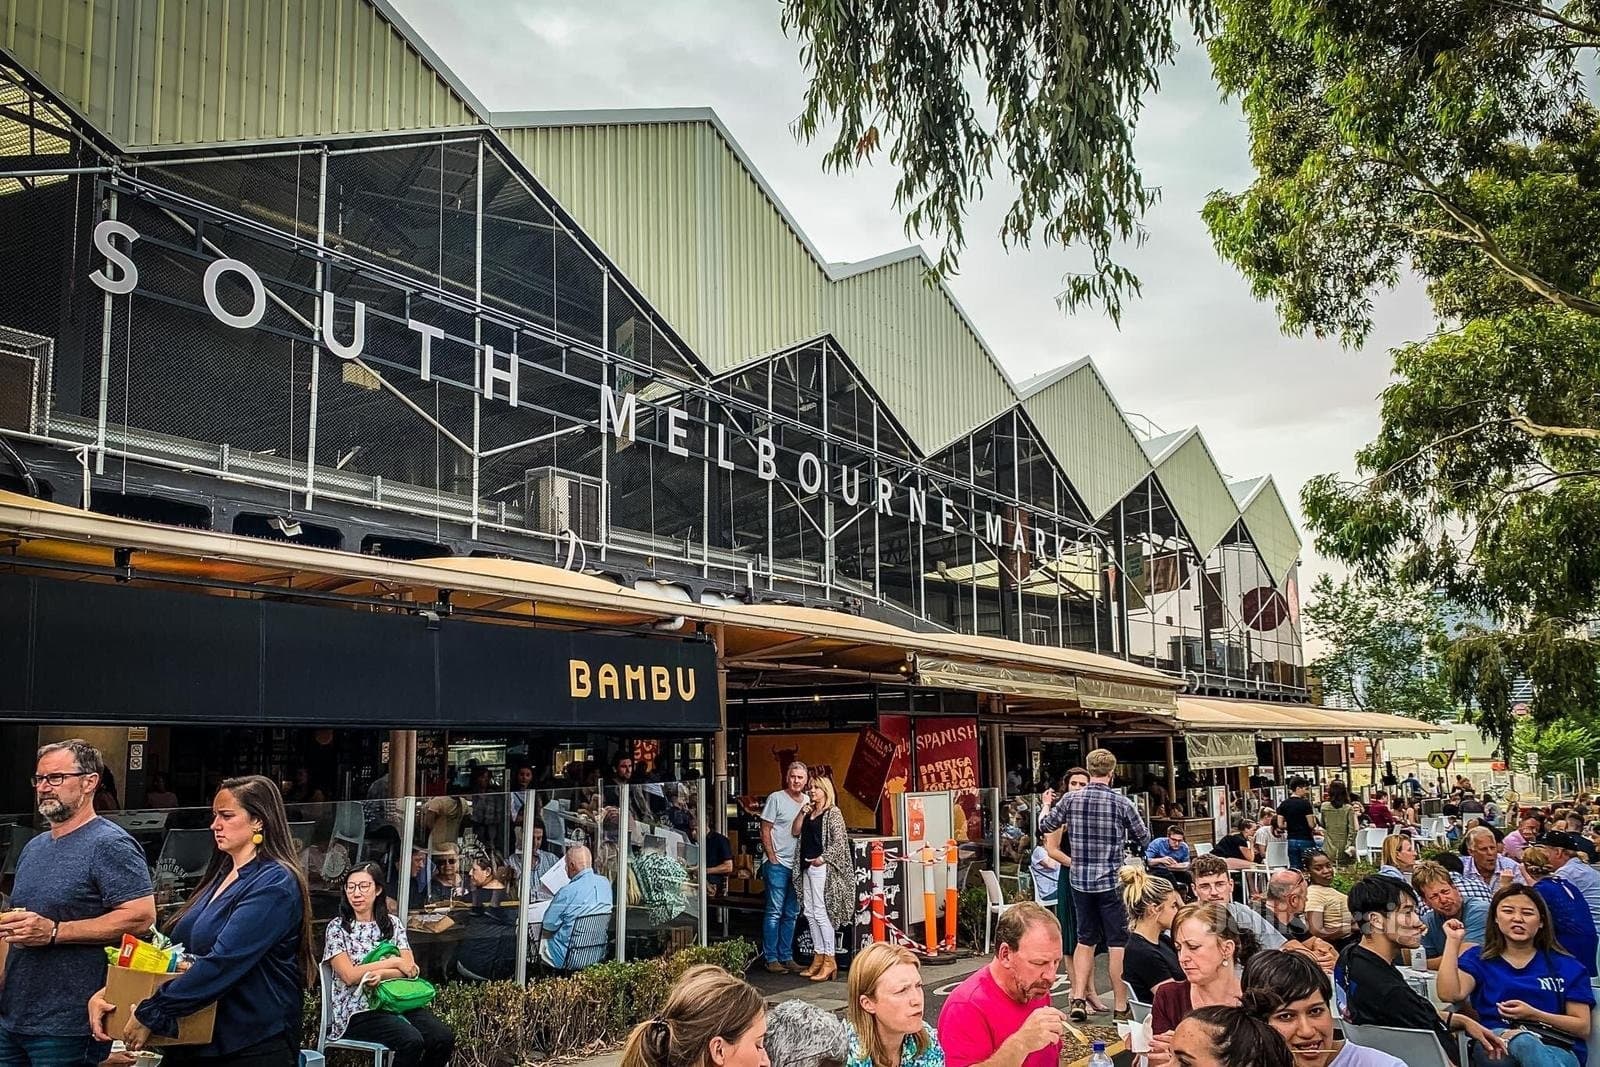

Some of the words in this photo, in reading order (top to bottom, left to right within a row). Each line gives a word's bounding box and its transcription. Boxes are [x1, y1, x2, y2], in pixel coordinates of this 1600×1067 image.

[89, 220, 519, 407] SOUTH
[601, 384, 955, 534] MELBOURNE
[569, 659, 696, 702] BAMBU
[915, 724, 978, 752] SPANISH
[919, 756, 973, 775] BARRIGA
